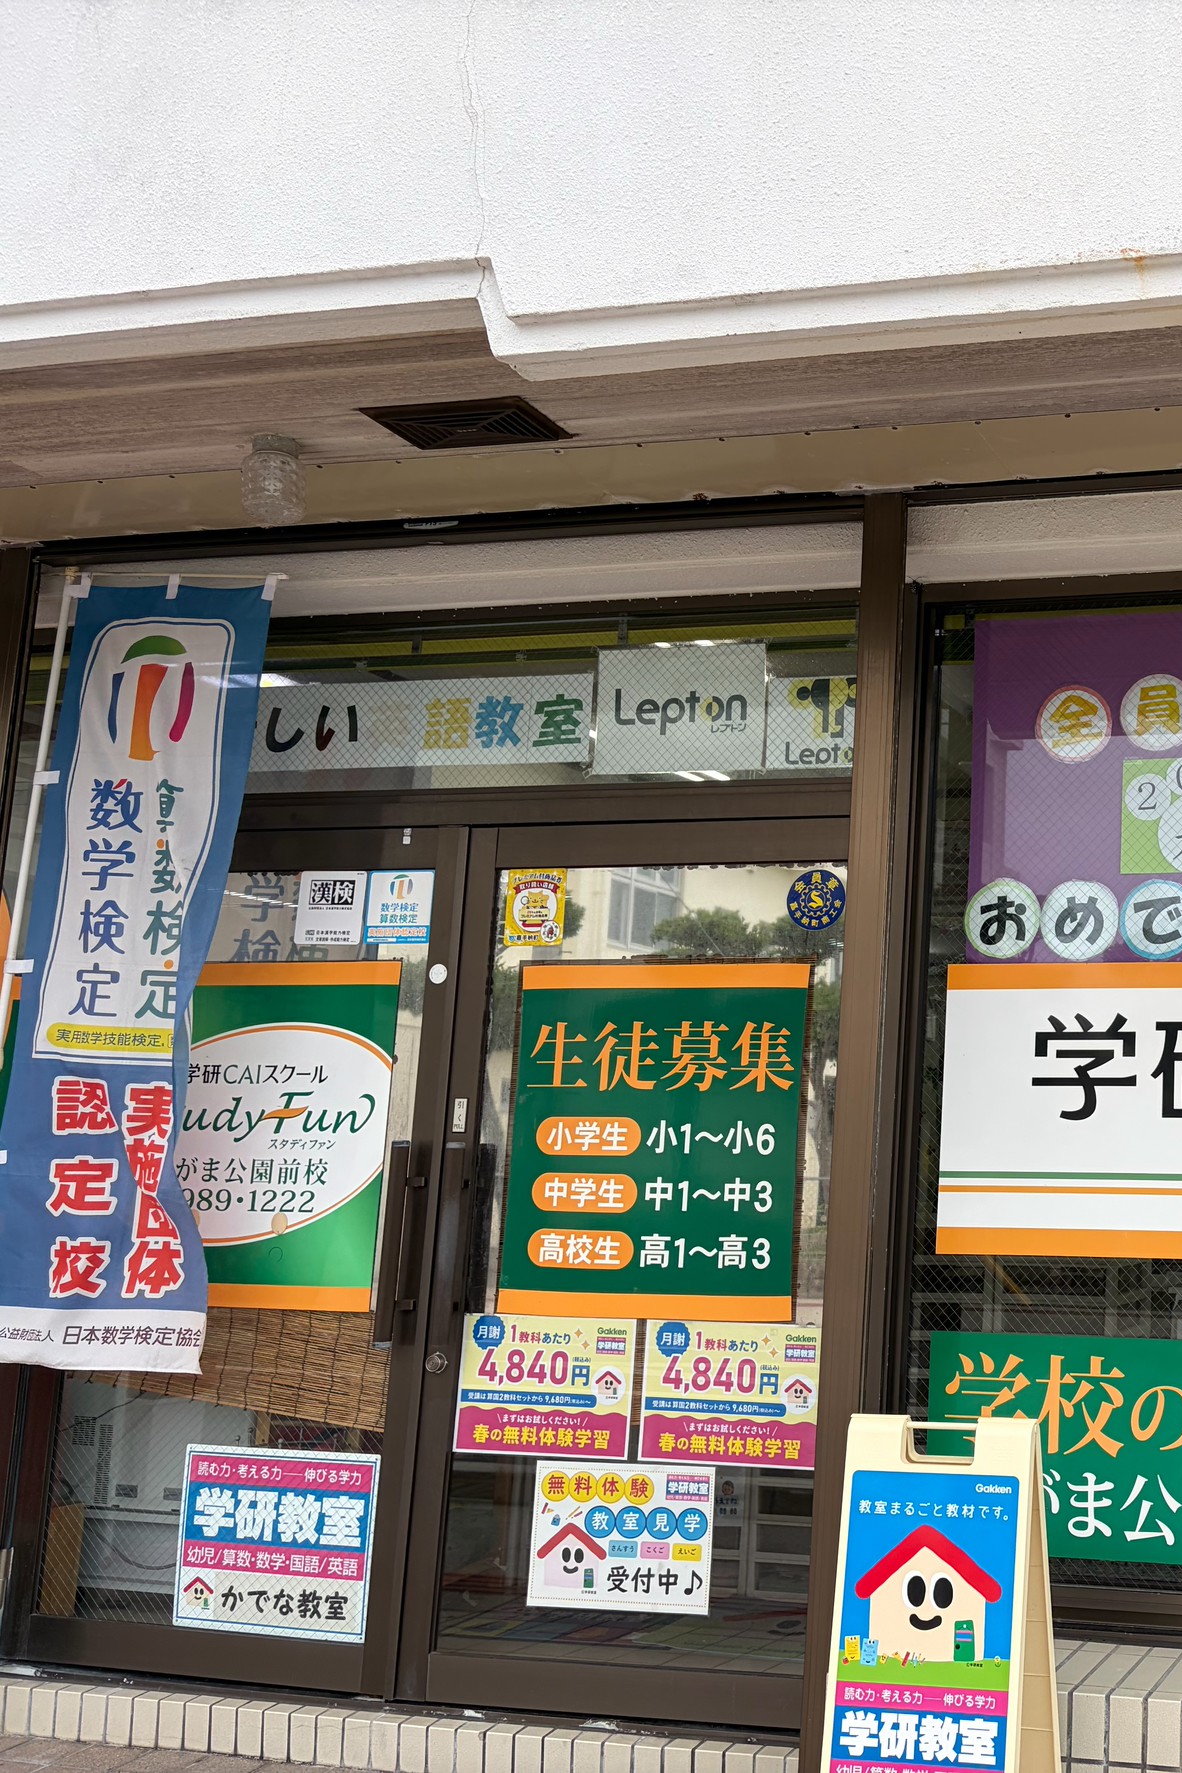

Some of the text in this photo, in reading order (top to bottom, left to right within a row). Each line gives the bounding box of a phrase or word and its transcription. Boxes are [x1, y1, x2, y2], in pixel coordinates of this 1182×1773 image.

[614, 688, 747, 735] Lepton
[711, 722, 747, 733] レプトン
[68, 778, 144, 1017] 数学検定
[309, 880, 356, 905] 漢検
[379, 913, 418, 924] 算数検定
[380, 902, 419, 913] 数学検定
[526, 1021, 795, 1092] 生徒募集
[268, 1138, 337, 1150] スタディファン
[546, 1120, 629, 1152] 小学生
[50, 1079, 117, 1296] 認定校
[543, 1177, 625, 1209] 中学生
[538, 1232, 621, 1265] 高校生
[476, 1324, 571, 1345] 月謝 1教科あたり
[597, 1327, 628, 1336] Gakken
[660, 1331, 759, 1352] 月謝 1教科あたり
[785, 1334, 817, 1343] Gakken
[597, 1341, 626, 1351] 学研教室
[786, 1348, 816, 1359] 学研教室
[477, 1348, 591, 1386] 4,840円
[661, 1355, 779, 1395] 4,840円
[502, 1414, 581, 1426] まずはお試しください!
[688, 1422, 770, 1436] まずはお試しください!
[472, 1424, 611, 1450] 春の無料体験学習
[658, 1432, 801, 1460] 春の無料体験学習
[547, 1474, 650, 1499] 無料体験
[668, 1481, 709, 1495] 学研教室
[975, 1483, 1012, 1494] Gakken
[193, 1487, 366, 1548] 学研教室
[591, 1509, 701, 1533] 教室見学
[858, 1499, 1009, 1521] 教室まるごと教材です。
[611, 1544, 635, 1553] さんすう
[645, 1545, 665, 1554] こくご
[677, 1547, 697, 1556] えいご
[220, 1585, 349, 1621] かでな教室
[839, 1710, 999, 1766] 学研教室
